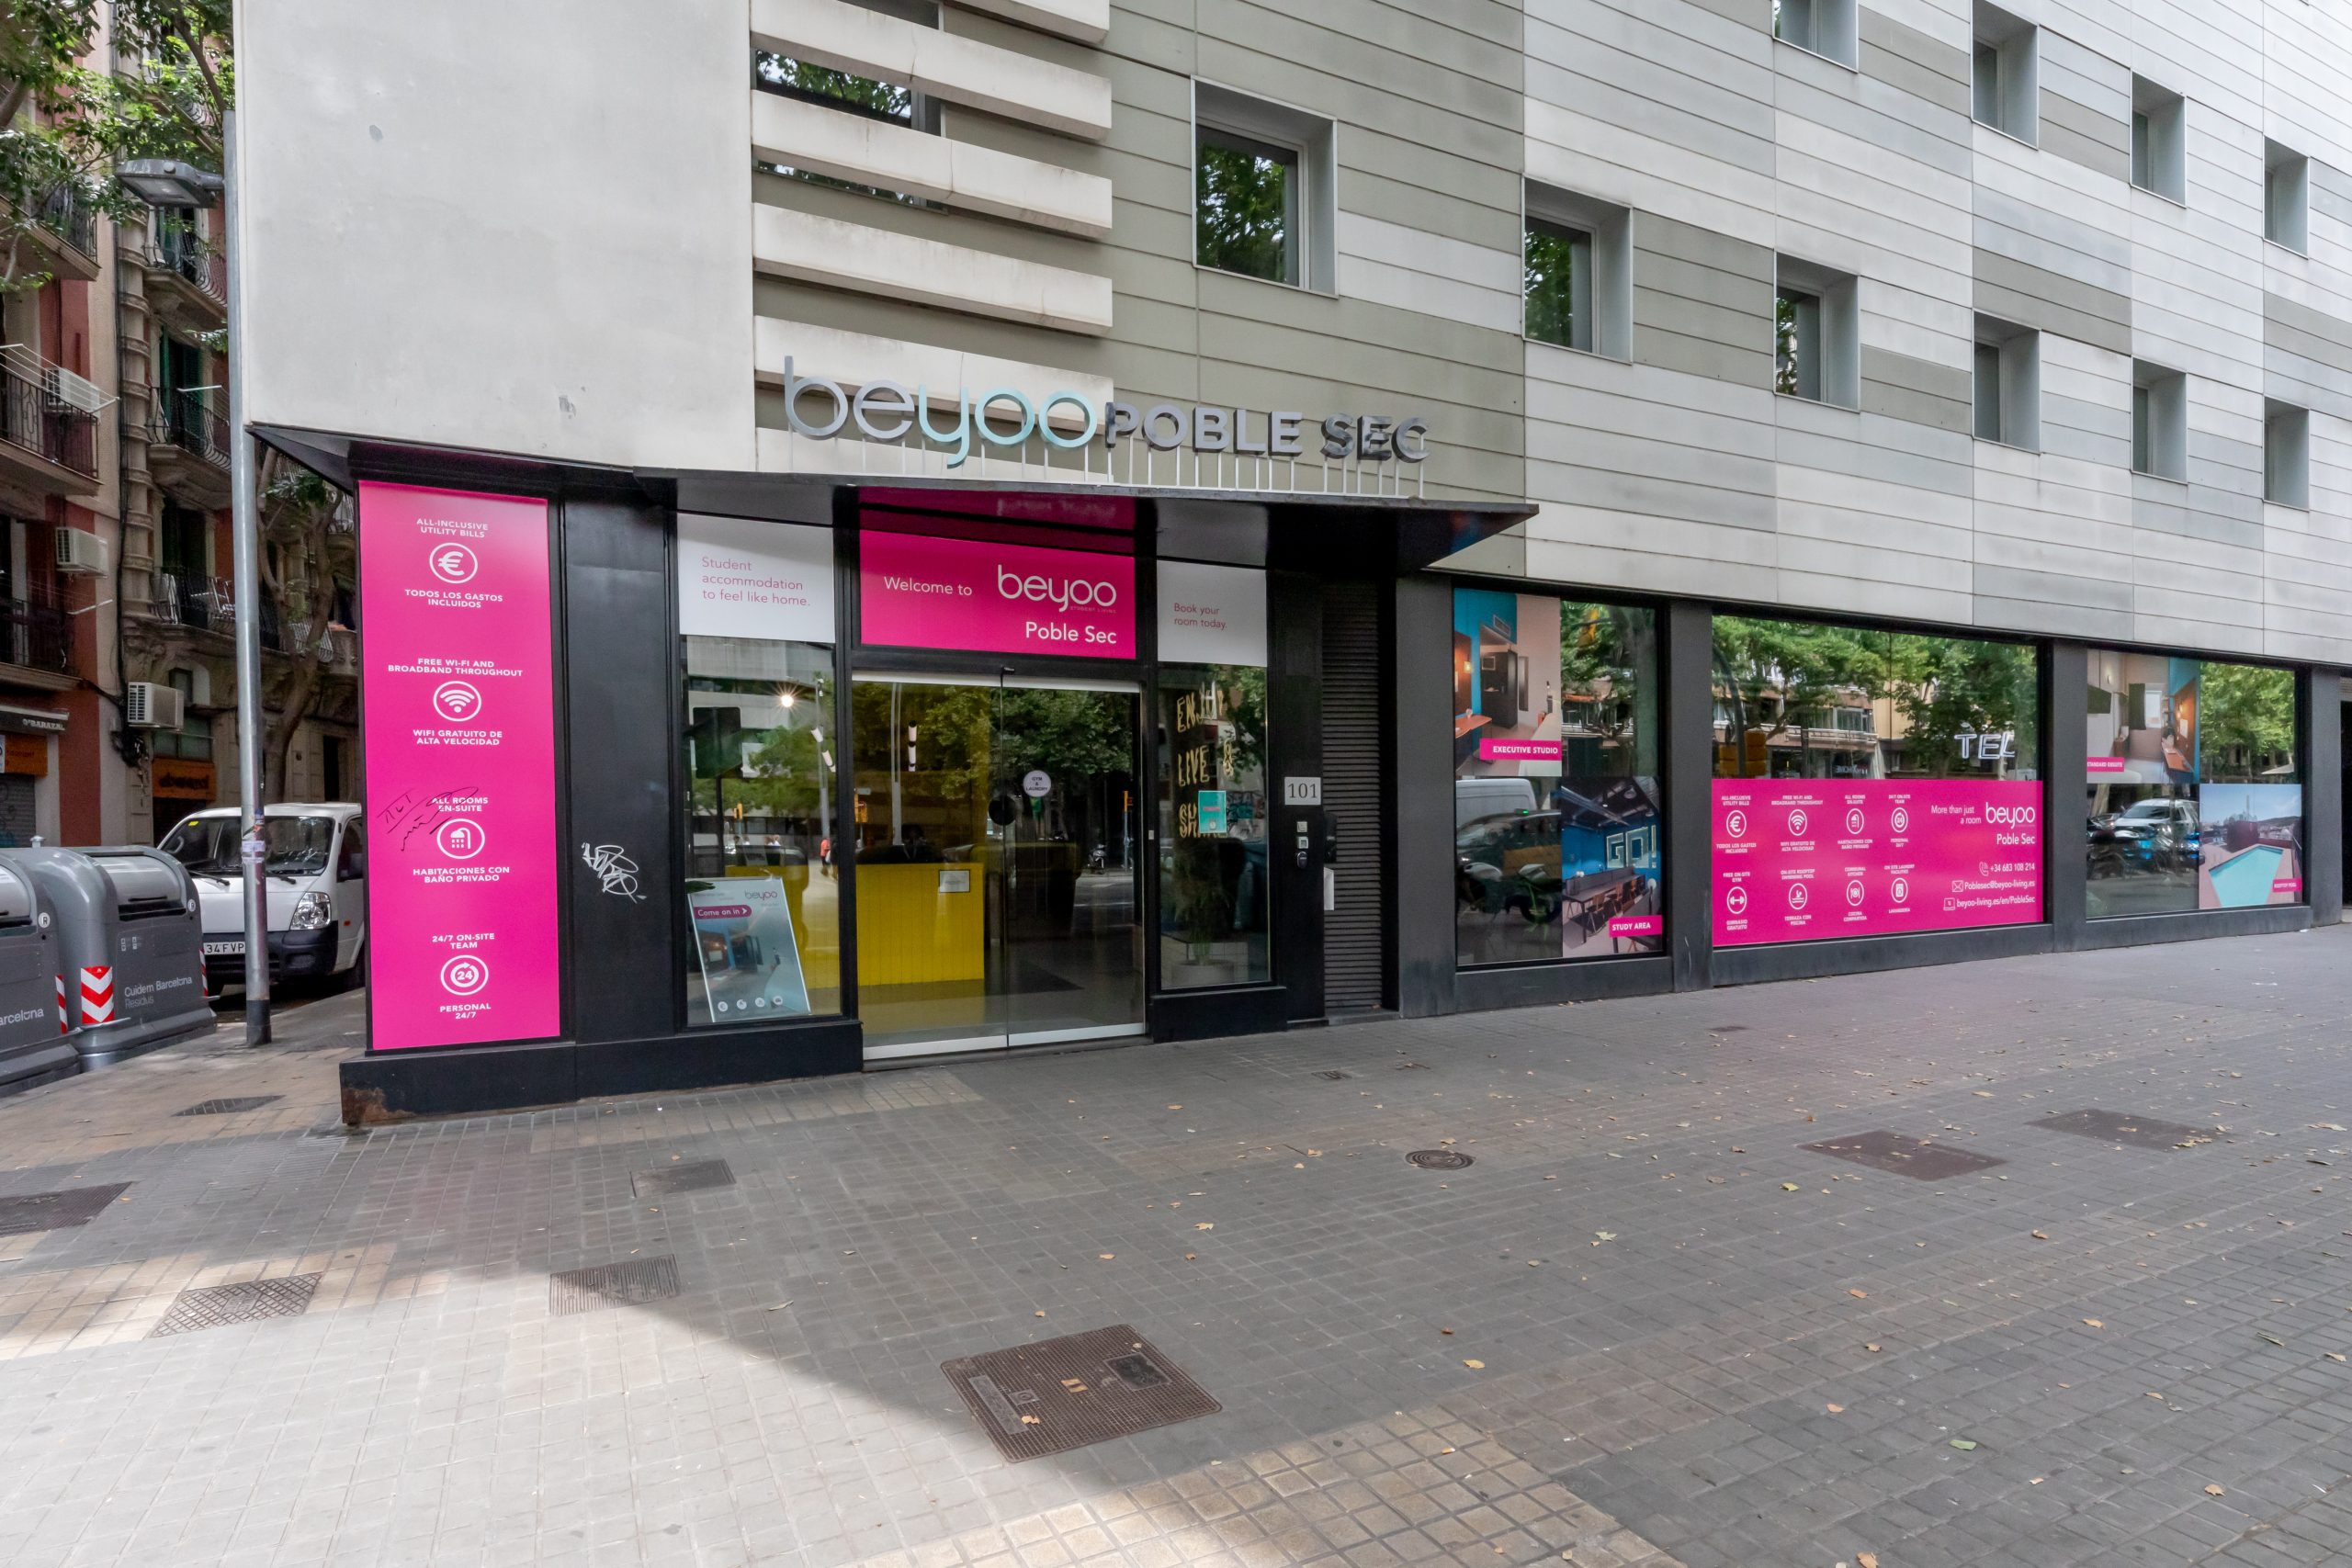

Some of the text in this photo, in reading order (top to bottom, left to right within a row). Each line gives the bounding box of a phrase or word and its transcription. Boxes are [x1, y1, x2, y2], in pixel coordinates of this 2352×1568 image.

[784, 355, 1098, 469] beyoo
[1105, 401, 1431, 462] POBLE SEC
[416, 518, 489, 531] ALL-INCLUSIVE
[420, 526, 485, 538] UTILITY BILLS
[701, 557, 752, 571] Student
[702, 575, 803, 591] accommodation
[883, 576, 972, 596] Welcome to
[998, 564, 1117, 613] beyoo
[404, 589, 440, 598] TODOS
[464, 593, 503, 602] GASTOS
[703, 590, 810, 606] to feel like home.
[427, 599, 481, 608] INCLUIDOS
[1173, 603, 1220, 617] Book your
[1174, 617, 1227, 631] room today.
[1025, 621, 1117, 645] Poble Sec
[417, 658, 442, 666] FREE
[445, 659, 470, 667] WI-FI
[388, 664, 523, 677] BROADBAND THROUGHOUT
[437, 729, 487, 738] GRATUITO
[443, 738, 500, 746] VELOCIDAD
[1493, 745, 1532, 753] EXECUTIVE
[1178, 745, 1210, 787] LIVE
[1287, 783, 1317, 799] 101
[432, 796, 489, 805] ALL ROOMS
[1931, 805, 1975, 816] More than just
[1985, 802, 2036, 829] beyoo
[1996, 833, 2036, 845] Poble Sec
[413, 867, 486, 875] HABITACIONES
[1990, 863, 2001, 873] +34
[2025, 863, 2035, 872] 214
[424, 873, 500, 883] BAÑO PRIVADO
[744, 890, 778, 901] beyoo
[697, 908, 719, 917] Come
[1612, 921, 1651, 931] STUDY AREA
[432, 932, 495, 942] 24/7 ON-SITE
[222, 942, 244, 953] FVP
[450, 941, 478, 950] TEAM
[457, 970, 473, 980] 24
[124, 976, 193, 997] Cuidem Barcelona
[124, 995, 154, 1010] Residus
[440, 1003, 492, 1012] PERSONAL
[455, 1011, 476, 1020] 24/7
